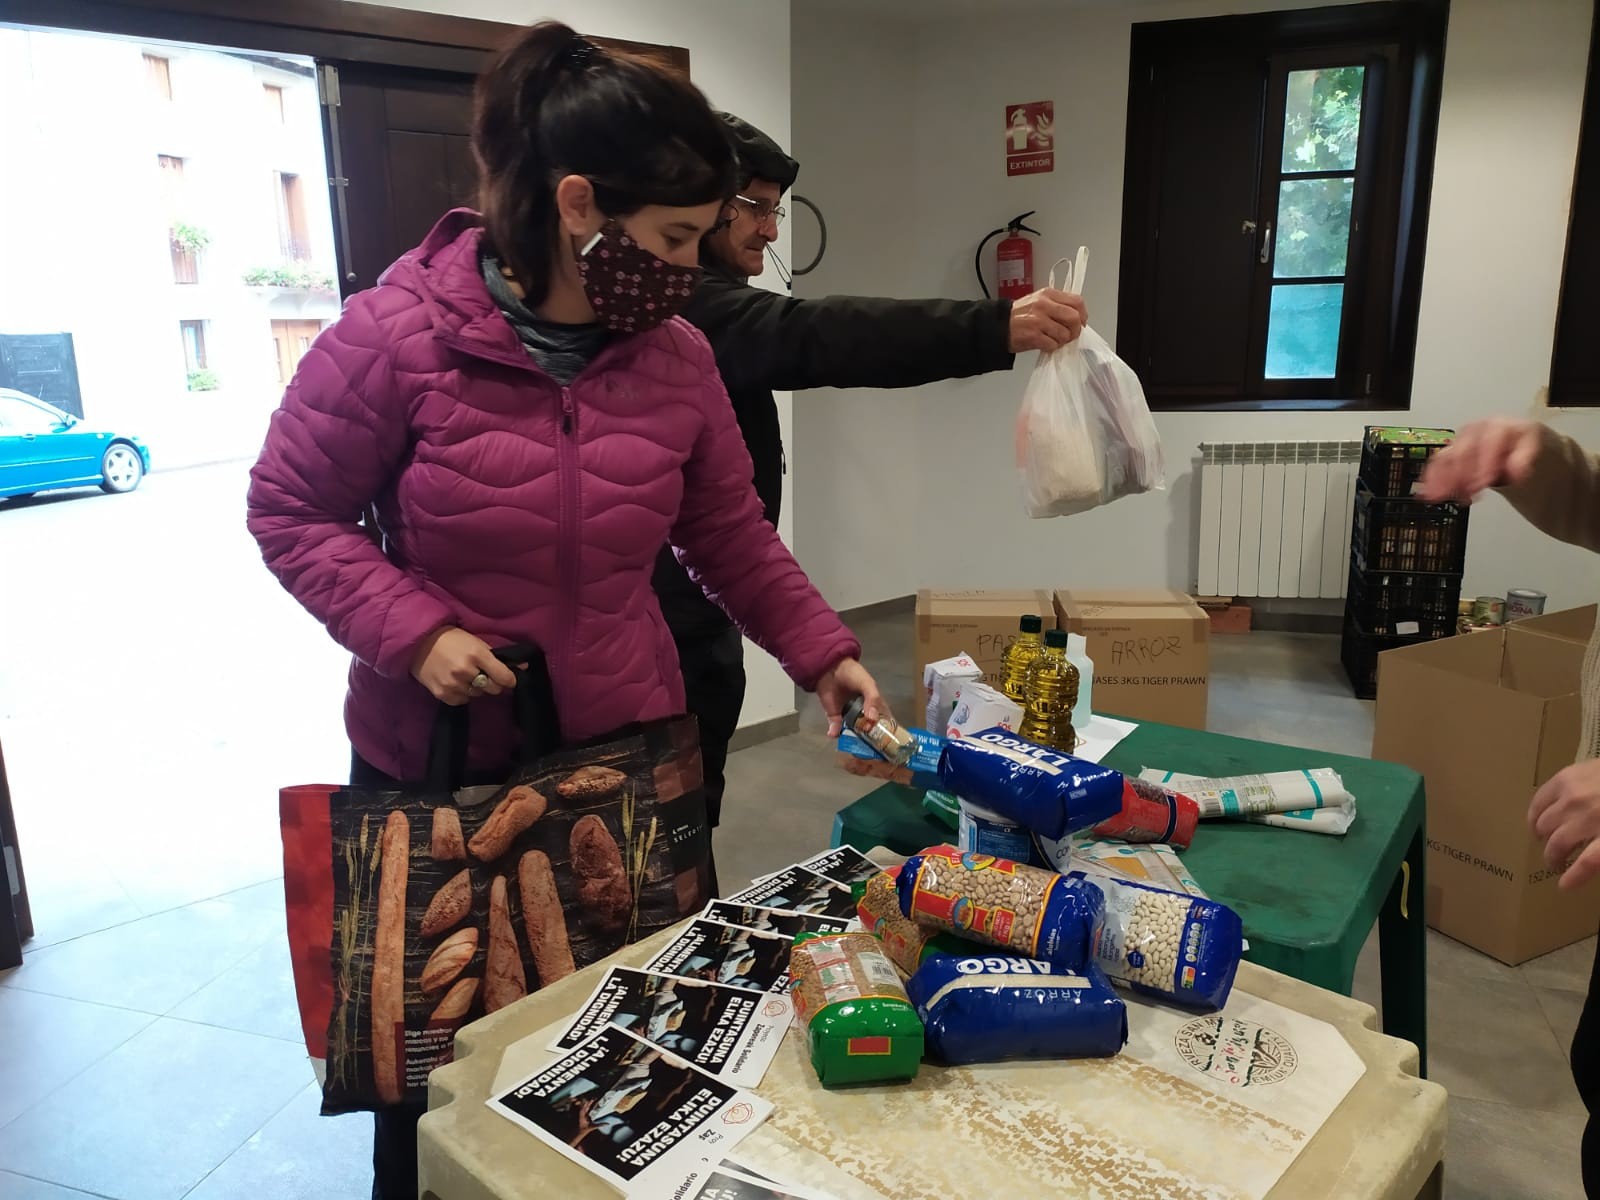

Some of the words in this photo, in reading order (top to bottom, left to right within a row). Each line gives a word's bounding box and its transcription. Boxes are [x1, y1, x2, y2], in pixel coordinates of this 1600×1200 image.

[1010, 158, 1050, 170] EXTINTOR
[1112, 636, 1181, 665] ARROZ
[1092, 677, 1118, 685] ASES
[1121, 677, 1140, 685] 3KG
[1142, 677, 1168, 685] TIGER
[1171, 677, 1205, 685] PRAWN
[981, 734, 1070, 766] LARGO
[1002, 759, 1044, 777] ARROZ
[829, 852, 845, 861] LA
[1442, 845, 1471, 864] TIGER
[1474, 858, 1514, 882] PRAWN
[780, 871, 796, 880] LA
[685, 926, 702, 937] LA
[956, 957, 1076, 975] ARGO
[605, 977, 622, 990] LA
[1024, 989, 1081, 999] ARROZ
[566, 992, 611, 1041] DIGNIDAD!
[717, 996, 742, 1026] ELIKA
[585, 1035, 609, 1052] LA
[694, 1028, 725, 1064] EZAZU!
[709, 1000, 755, 1064] DUINTASUNA
[513, 1048, 588, 1100] DIGNIDAD!
[533, 1047, 610, 1098] ¡ALIMENTA
[668, 1088, 713, 1120] ELIKA
[616, 1119, 673, 1163] EZAZU!
[630, 1096, 723, 1167] DUINTASUNA
